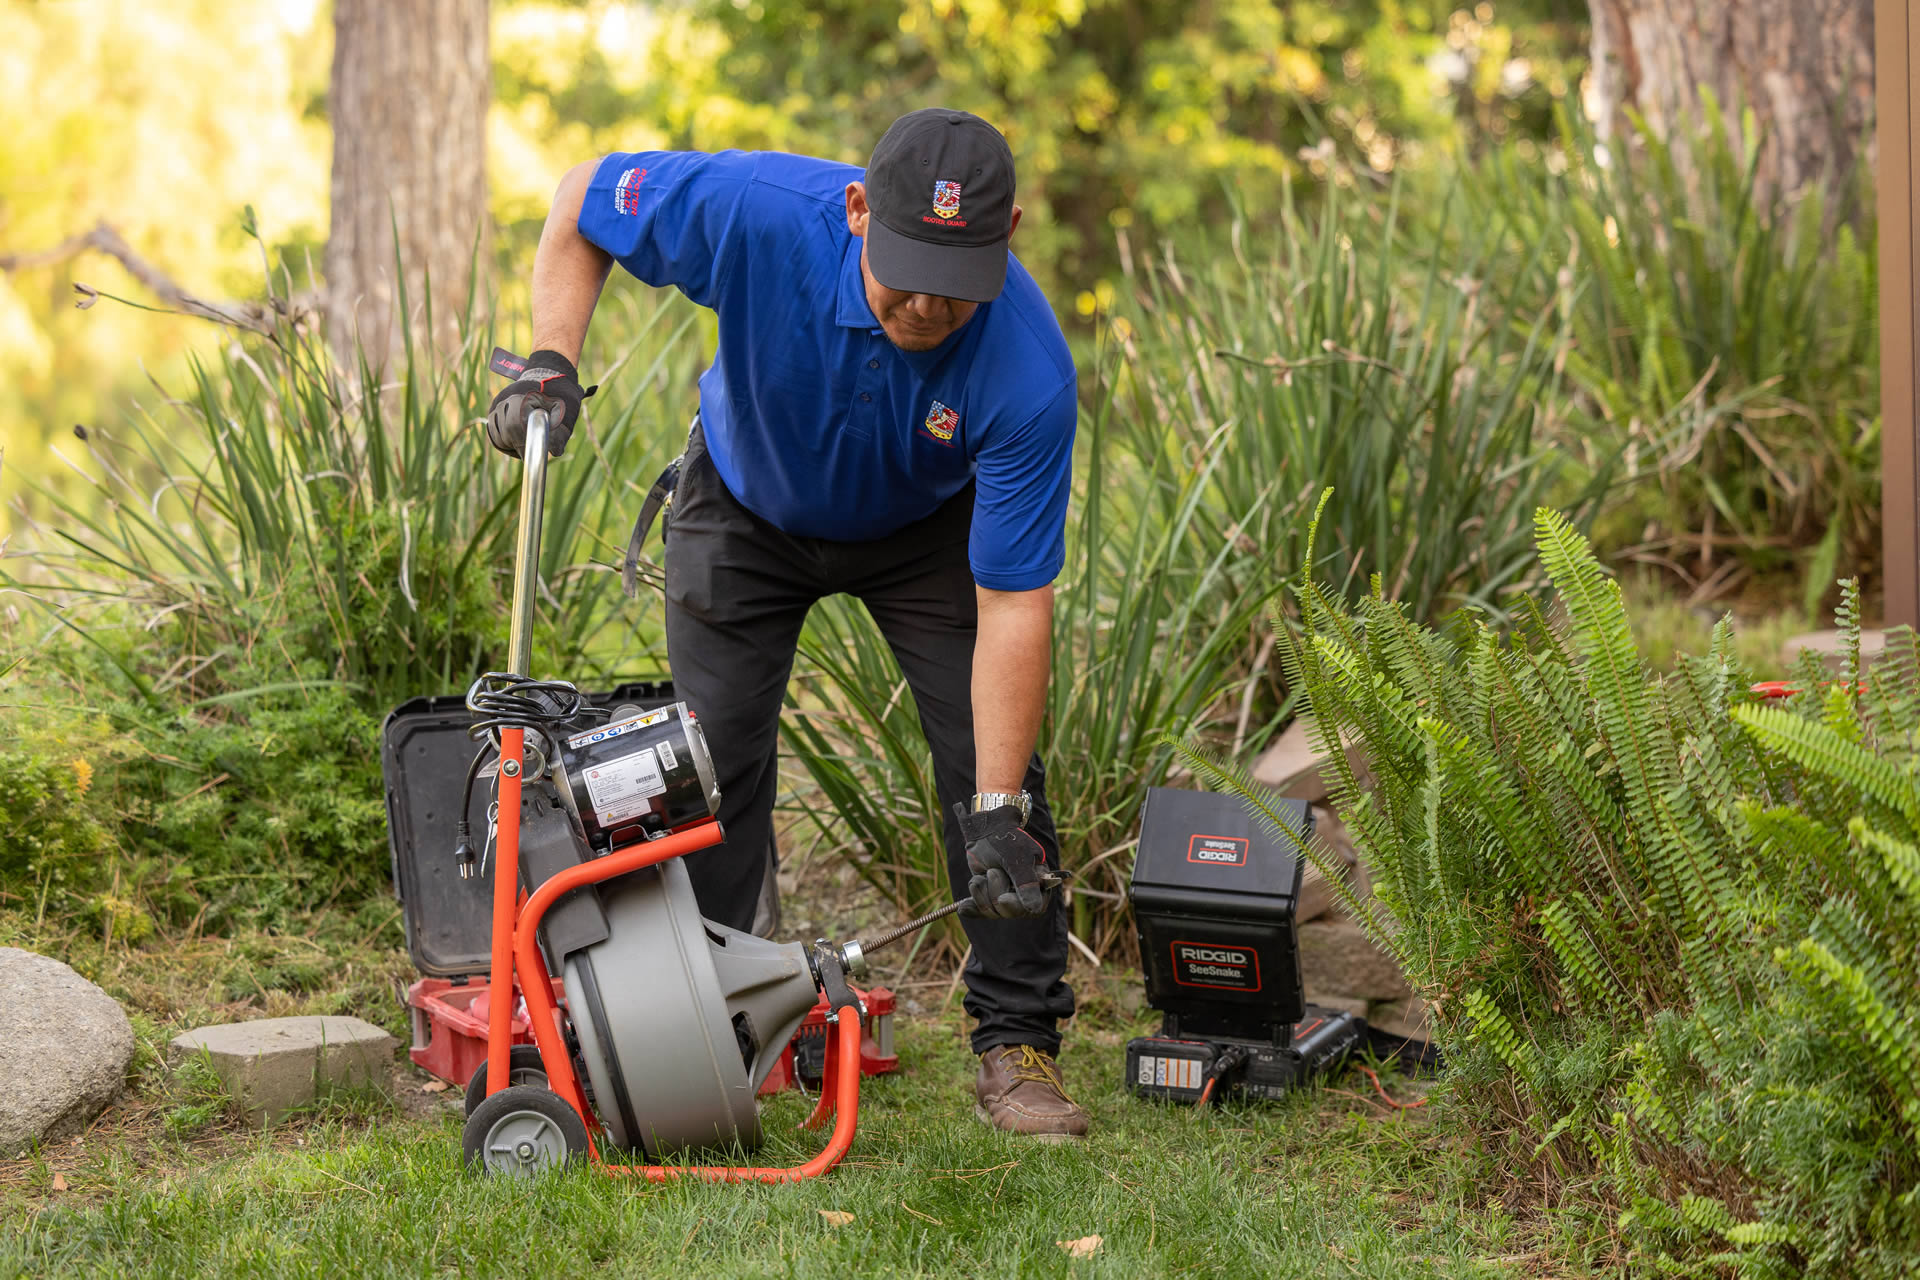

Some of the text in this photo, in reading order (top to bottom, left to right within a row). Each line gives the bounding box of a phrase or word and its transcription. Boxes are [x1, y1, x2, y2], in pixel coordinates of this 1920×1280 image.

[624, 167, 641, 209] GUARD
[631, 168, 648, 216] ROOTER
[922, 215, 967, 227] ROOTER GUARD
[1198, 850, 1237, 862] RIDGID
[1181, 947, 1247, 964] RIDGID
[1189, 963, 1242, 978] SeeSnake
